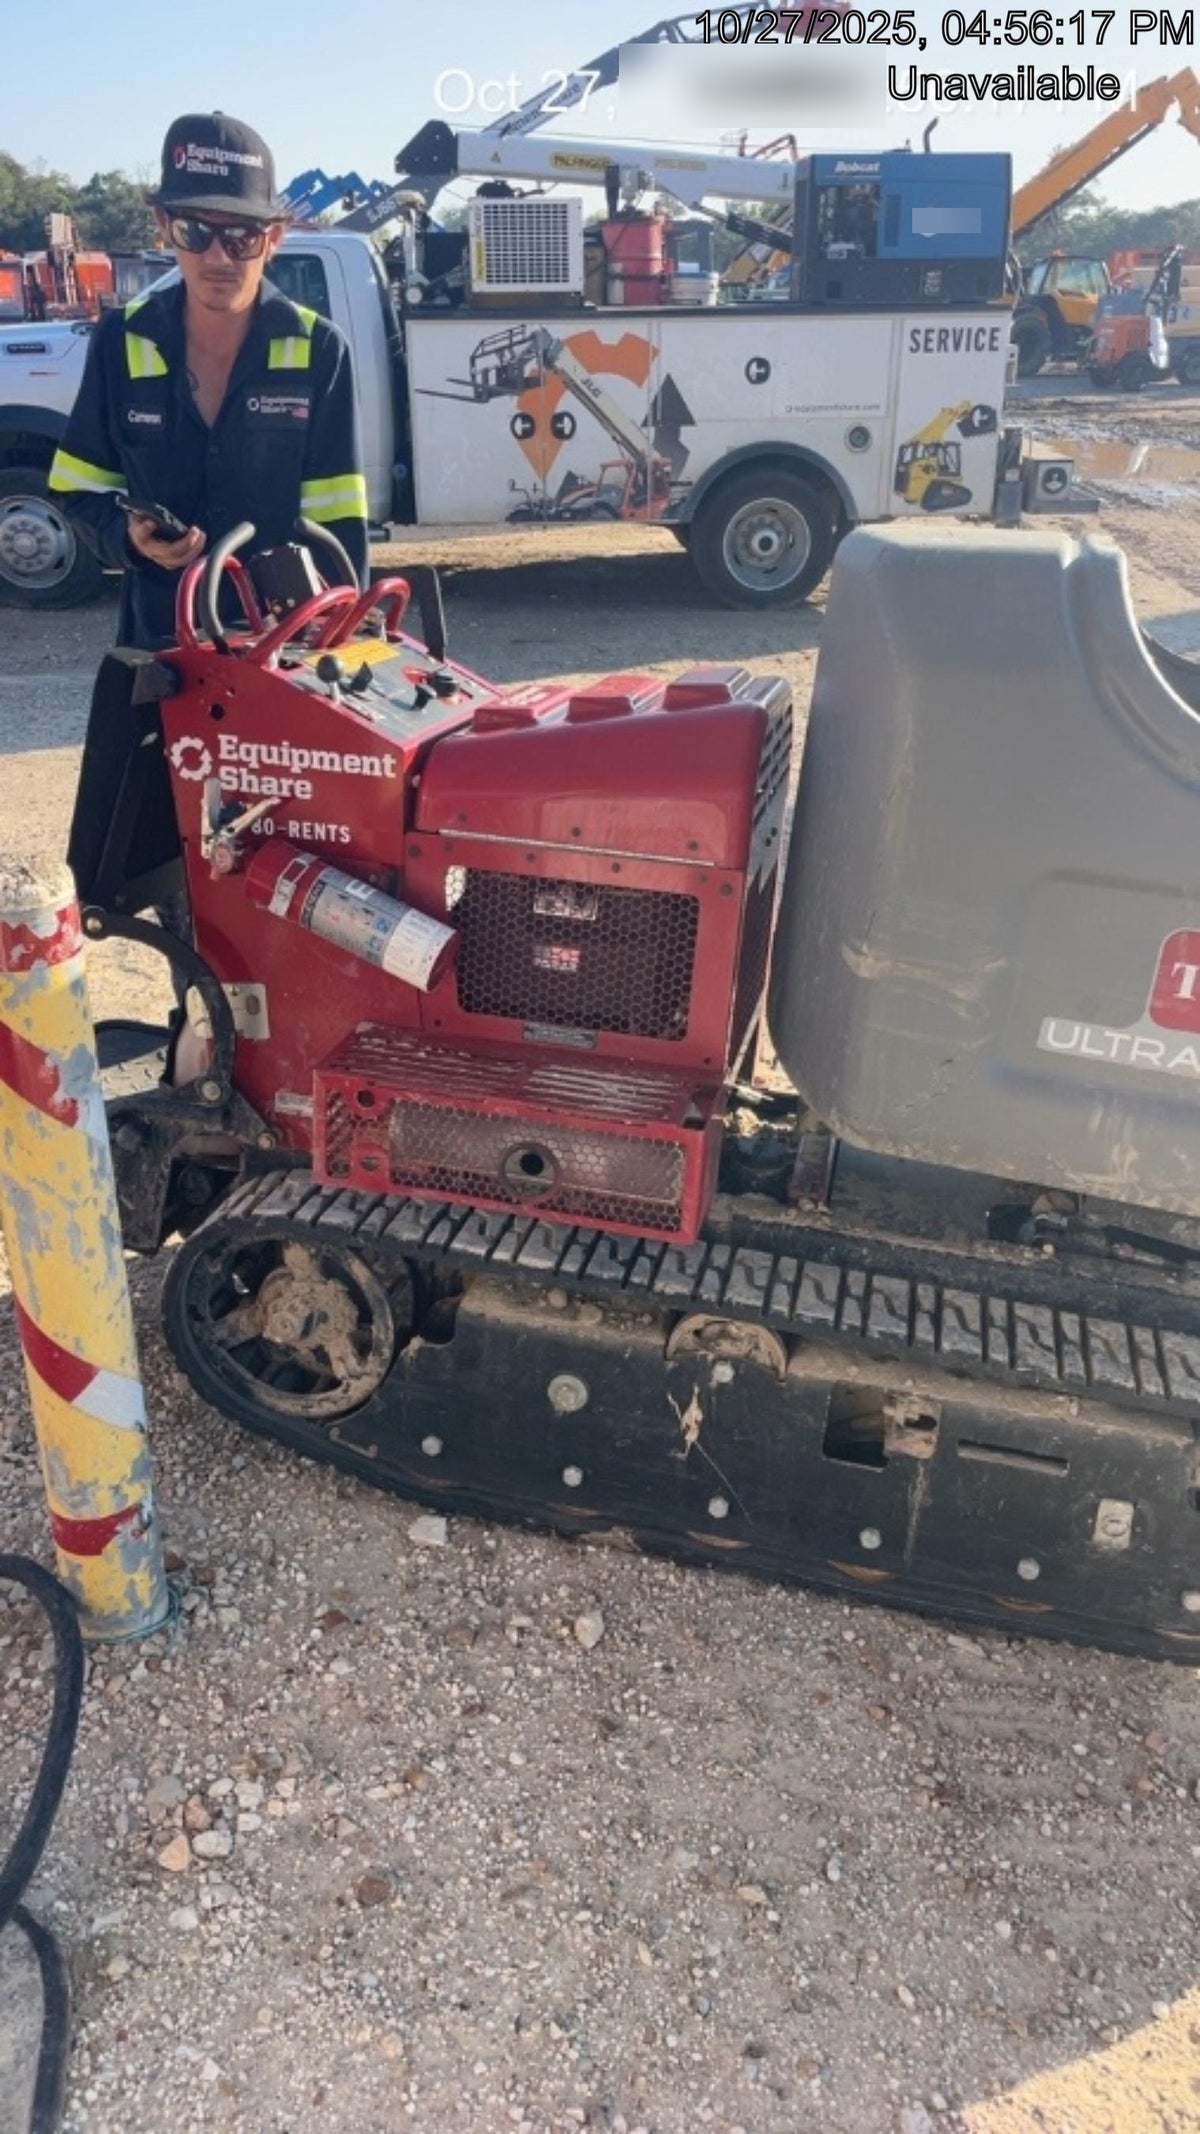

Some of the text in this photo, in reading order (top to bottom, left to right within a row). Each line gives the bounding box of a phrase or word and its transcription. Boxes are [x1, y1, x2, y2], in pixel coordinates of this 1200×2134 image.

[186, 143, 264, 169] Equipment
[186, 159, 229, 176] Share
[834, 161, 881, 173] Bobcat
[909, 326, 1001, 354] SERVICE
[217, 734, 397, 778] Equipment
[217, 765, 313, 799] Share
[1048, 1021, 1200, 1073] ULTRA
